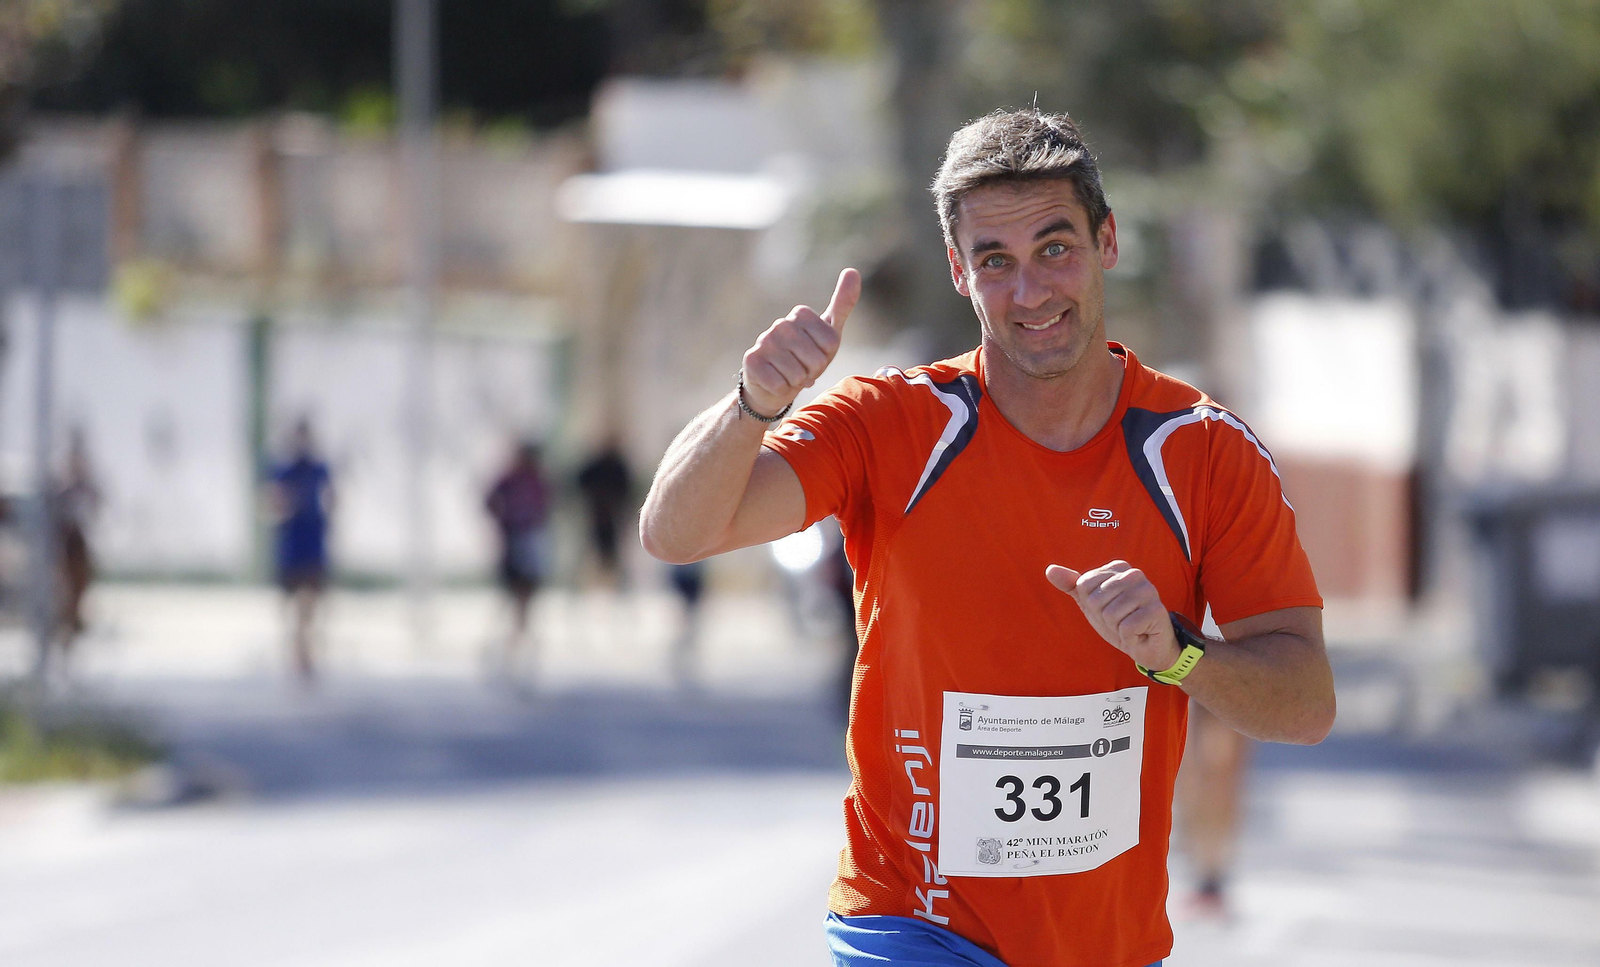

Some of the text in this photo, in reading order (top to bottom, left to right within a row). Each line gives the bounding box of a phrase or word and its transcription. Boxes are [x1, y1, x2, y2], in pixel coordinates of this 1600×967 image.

[1081, 518, 1120, 529] Kalenji
[977, 715, 1085, 726] Ayuntamiento de Málaga
[1102, 708, 1131, 722] 2020
[972, 747, 1064, 758] www.deporte.malaga.eu
[994, 772, 1091, 822] 331
[1026, 837, 1053, 847] MINI
[1056, 828, 1109, 846] MARATÓN
[1007, 848, 1037, 859] PEÑA
[1039, 849, 1055, 858] EL
